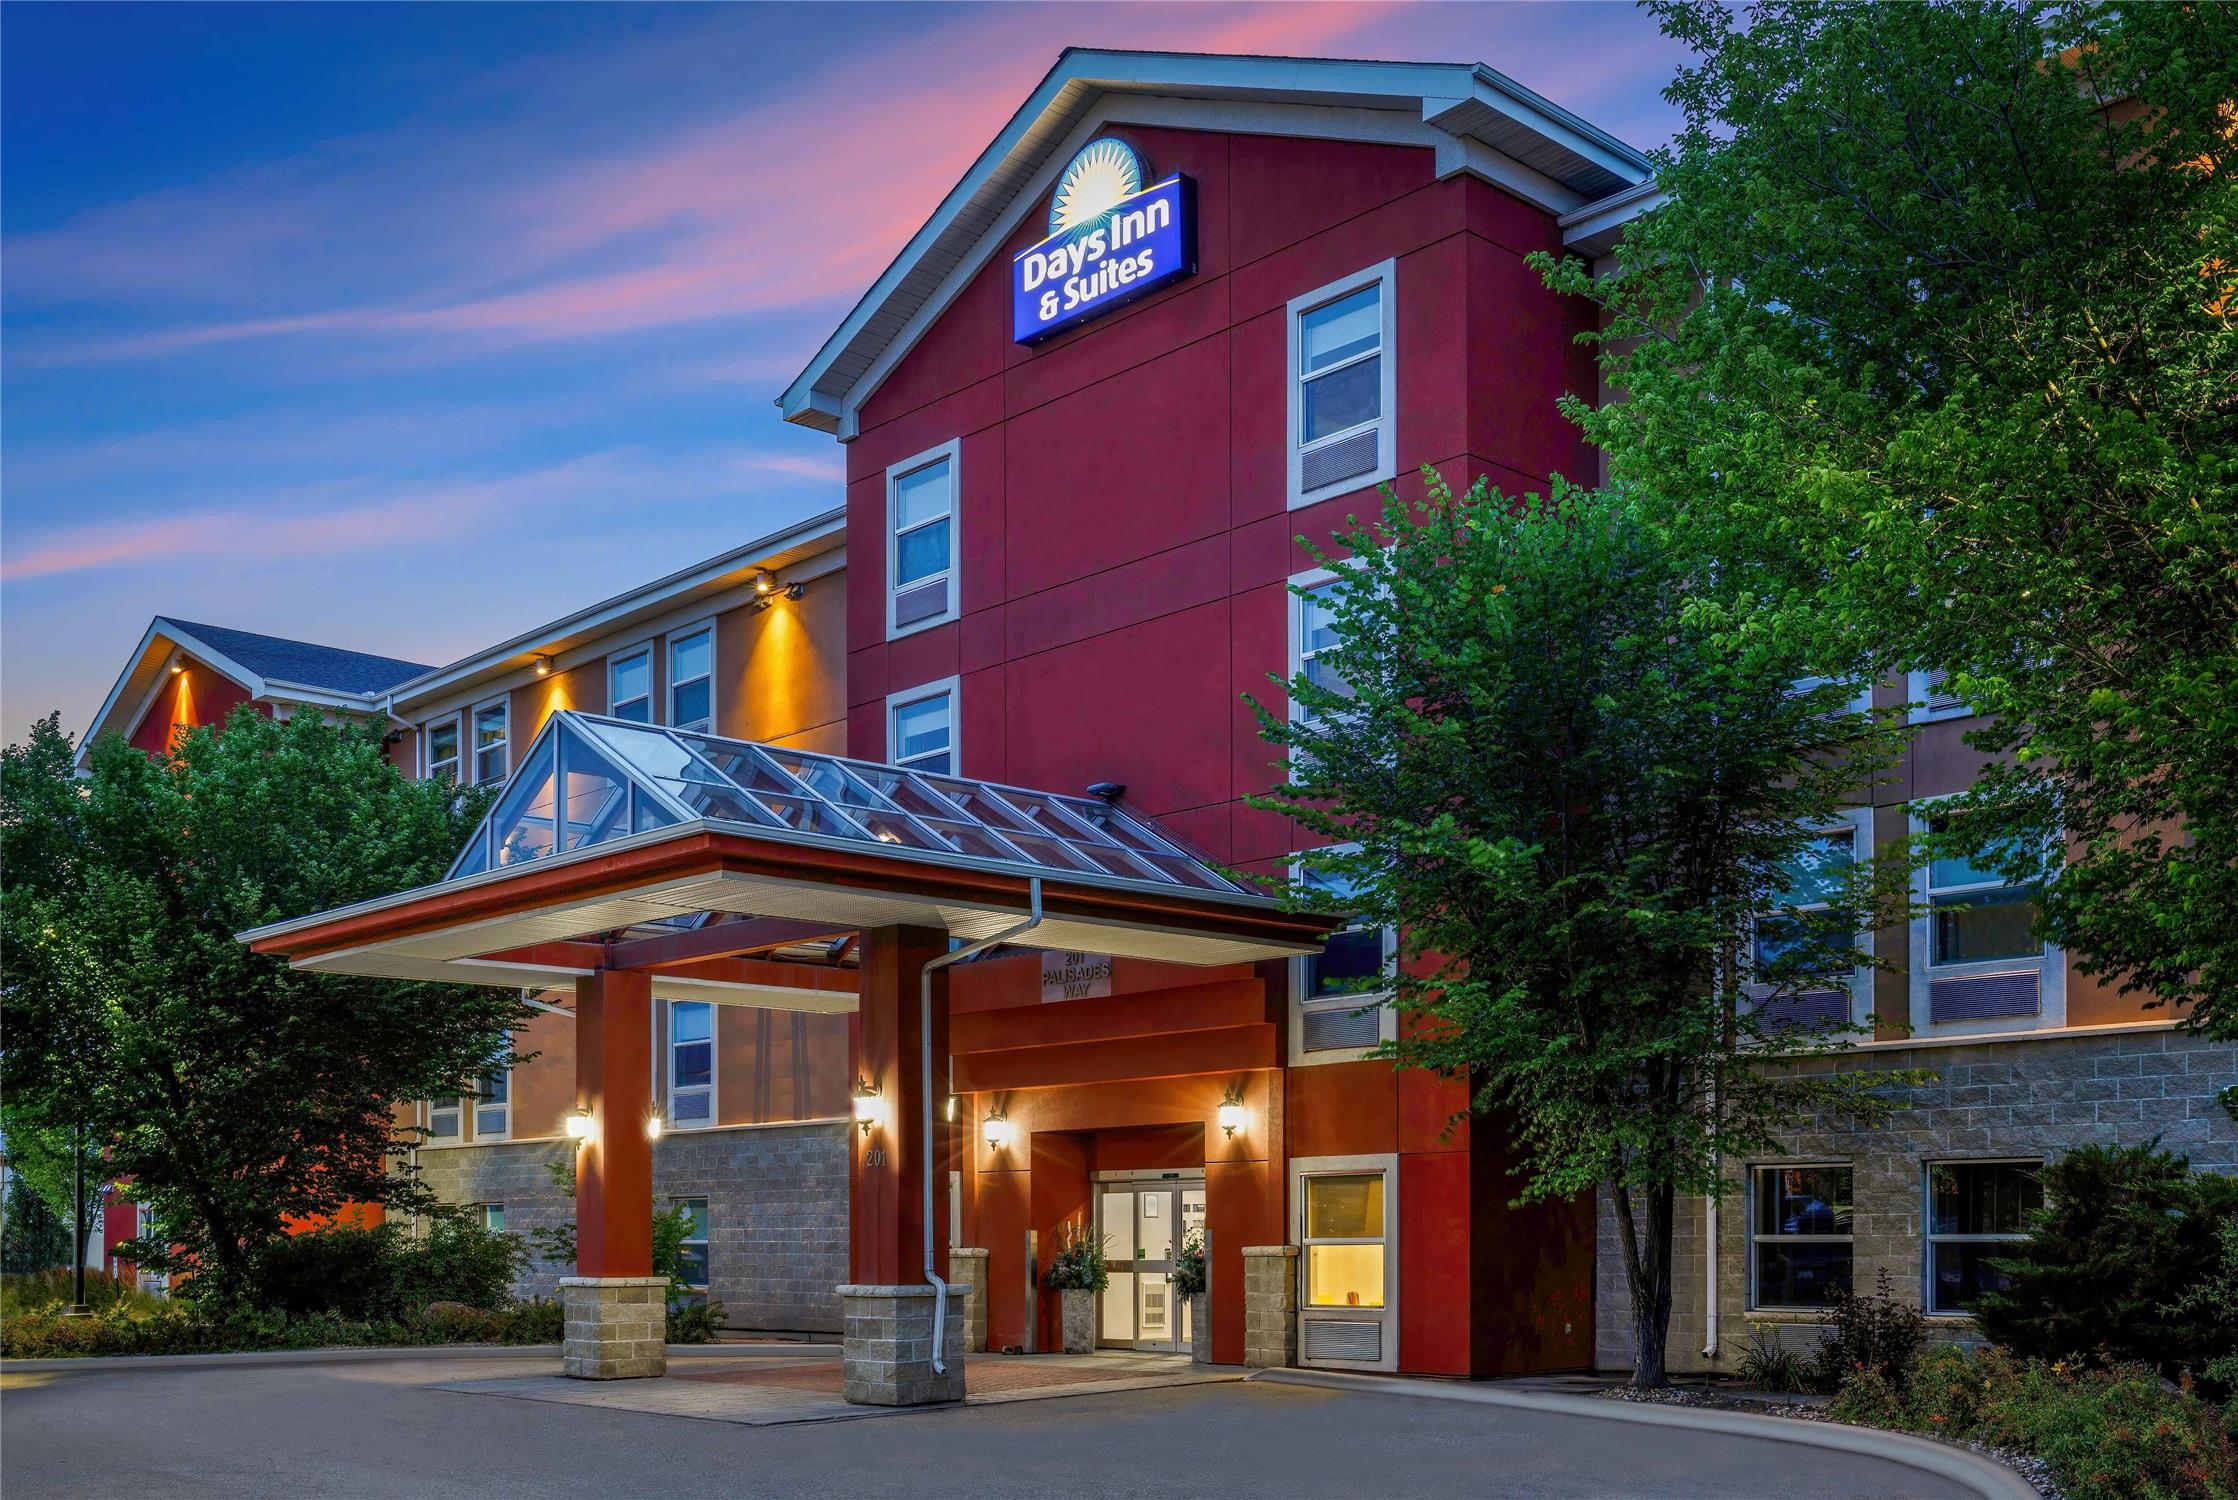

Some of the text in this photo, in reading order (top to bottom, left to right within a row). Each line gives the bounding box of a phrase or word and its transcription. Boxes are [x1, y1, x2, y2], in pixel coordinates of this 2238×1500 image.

[1024, 198, 1169, 292] Days Inn
[1039, 249, 1153, 321] & Suites
[1065, 952, 1085, 966] 201
[1043, 963, 1111, 985] PALISADES
[1064, 983, 1089, 999] WAY
[866, 1149, 886, 1167] 201
